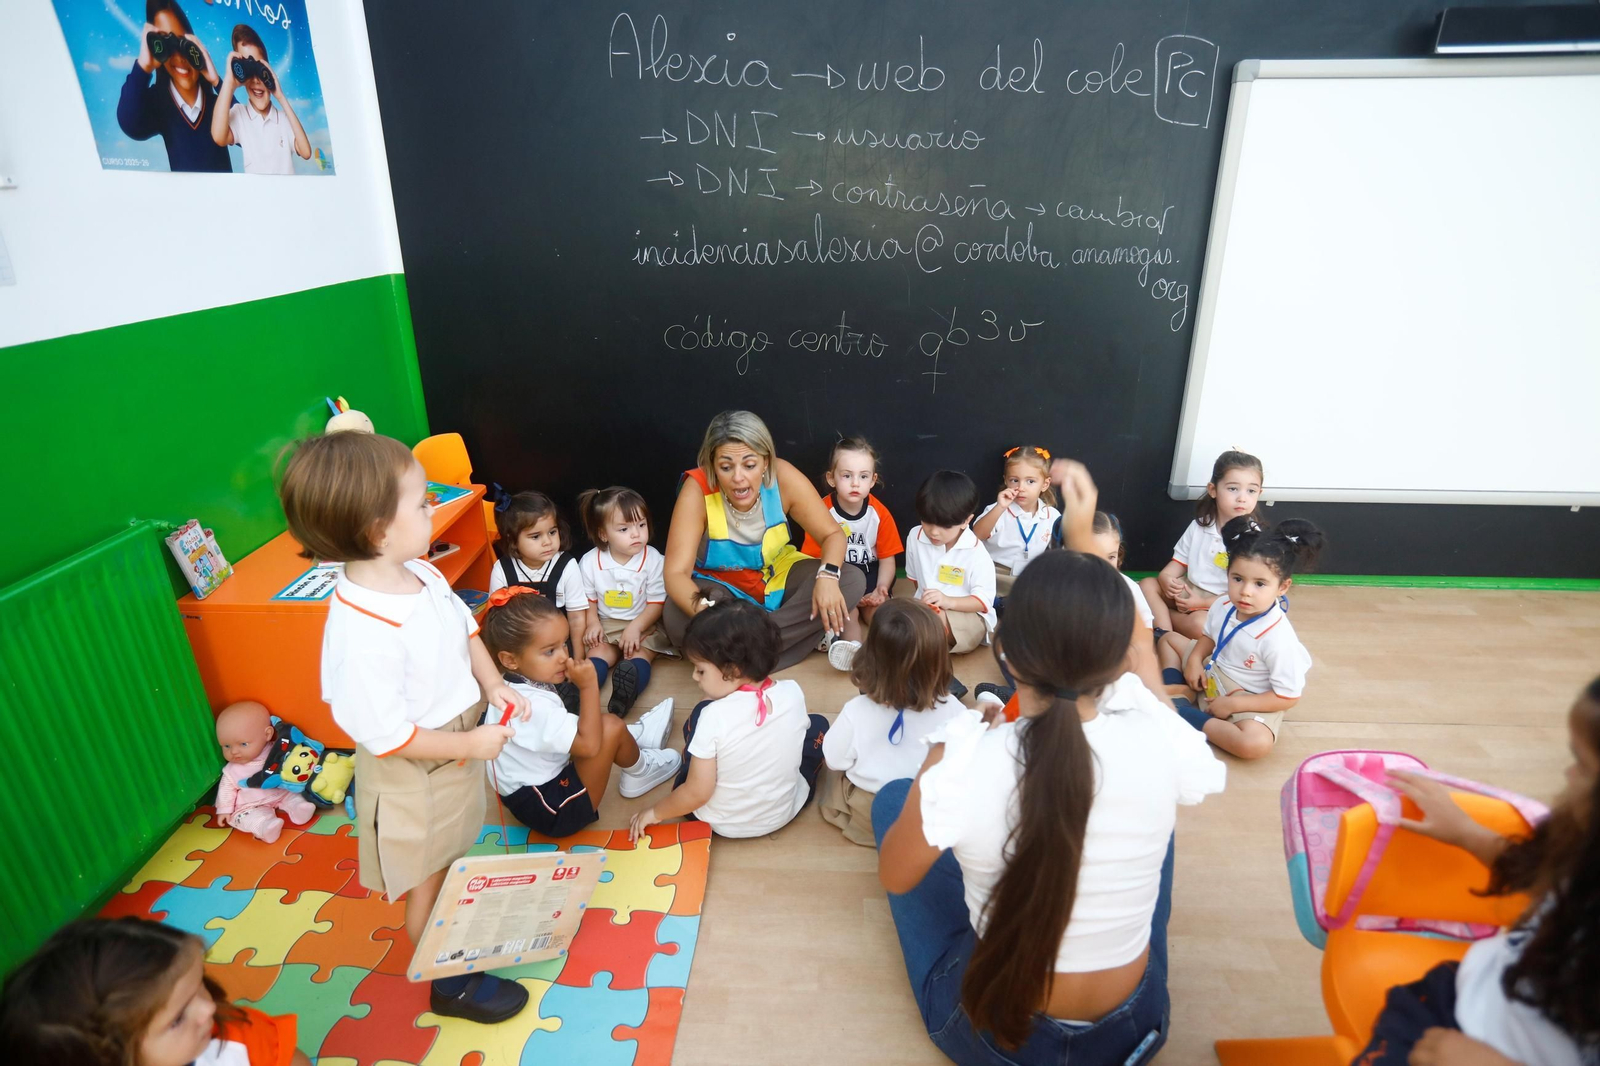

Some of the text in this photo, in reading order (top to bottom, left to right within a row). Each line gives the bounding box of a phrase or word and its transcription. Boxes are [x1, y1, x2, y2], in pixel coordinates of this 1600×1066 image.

[608, 12, 783, 91] Alexia
[857, 34, 946, 92] web
[979, 37, 1046, 93] del
[1066, 42, 1151, 97] cole
[685, 109, 986, 155] DNI usuario
[101, 157, 124, 166] CURSO
[695, 162, 785, 201] DNI
[832, 173, 1016, 221] contraseña
[1151, 277, 1189, 332] org
[663, 314, 774, 376] código
[788, 310, 890, 358] centro
